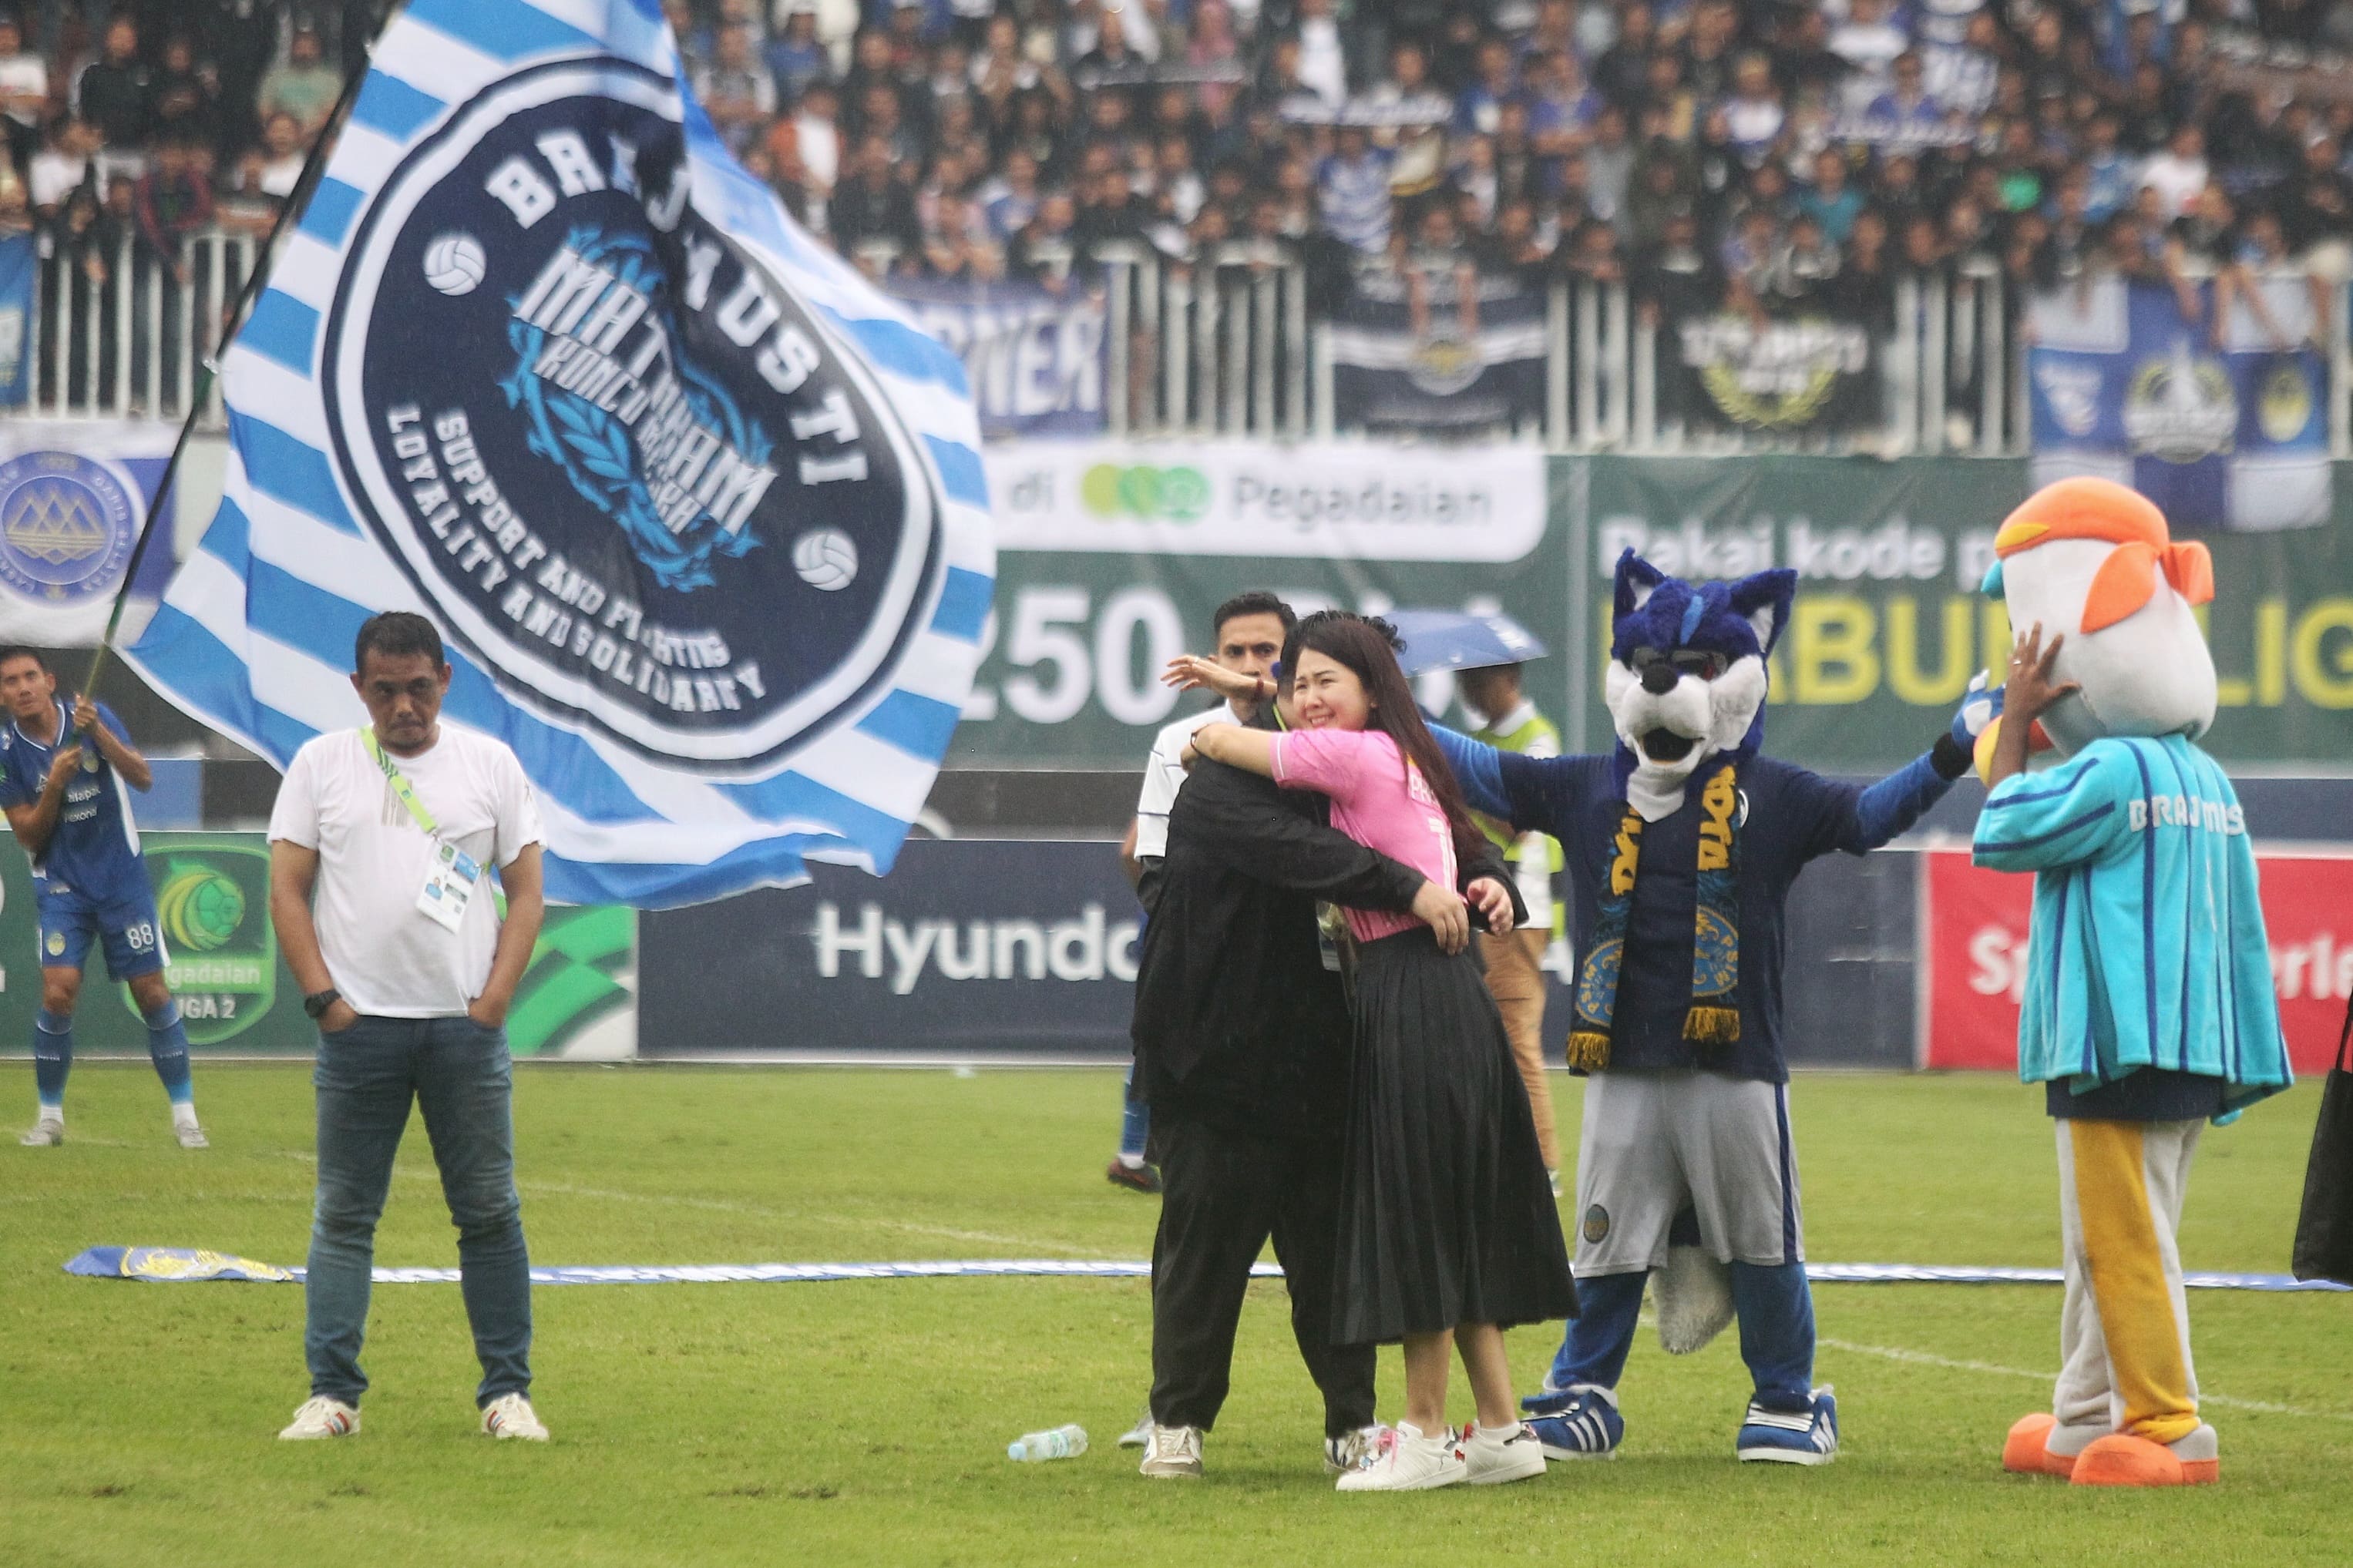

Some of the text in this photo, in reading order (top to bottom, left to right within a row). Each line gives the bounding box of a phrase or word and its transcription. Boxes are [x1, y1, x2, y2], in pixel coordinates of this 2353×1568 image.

[387, 405, 509, 593] LOYALITY
[434, 409, 546, 570] SUPPORT
[537, 556, 607, 616] AND
[1007, 472, 1492, 530] di Pegadaian
[1598, 518, 1775, 579] Pakai
[1787, 516, 1945, 579] kode
[126, 923, 154, 949] 88
[169, 962, 261, 989] gadaian
[176, 995, 236, 1019] IGA 2
